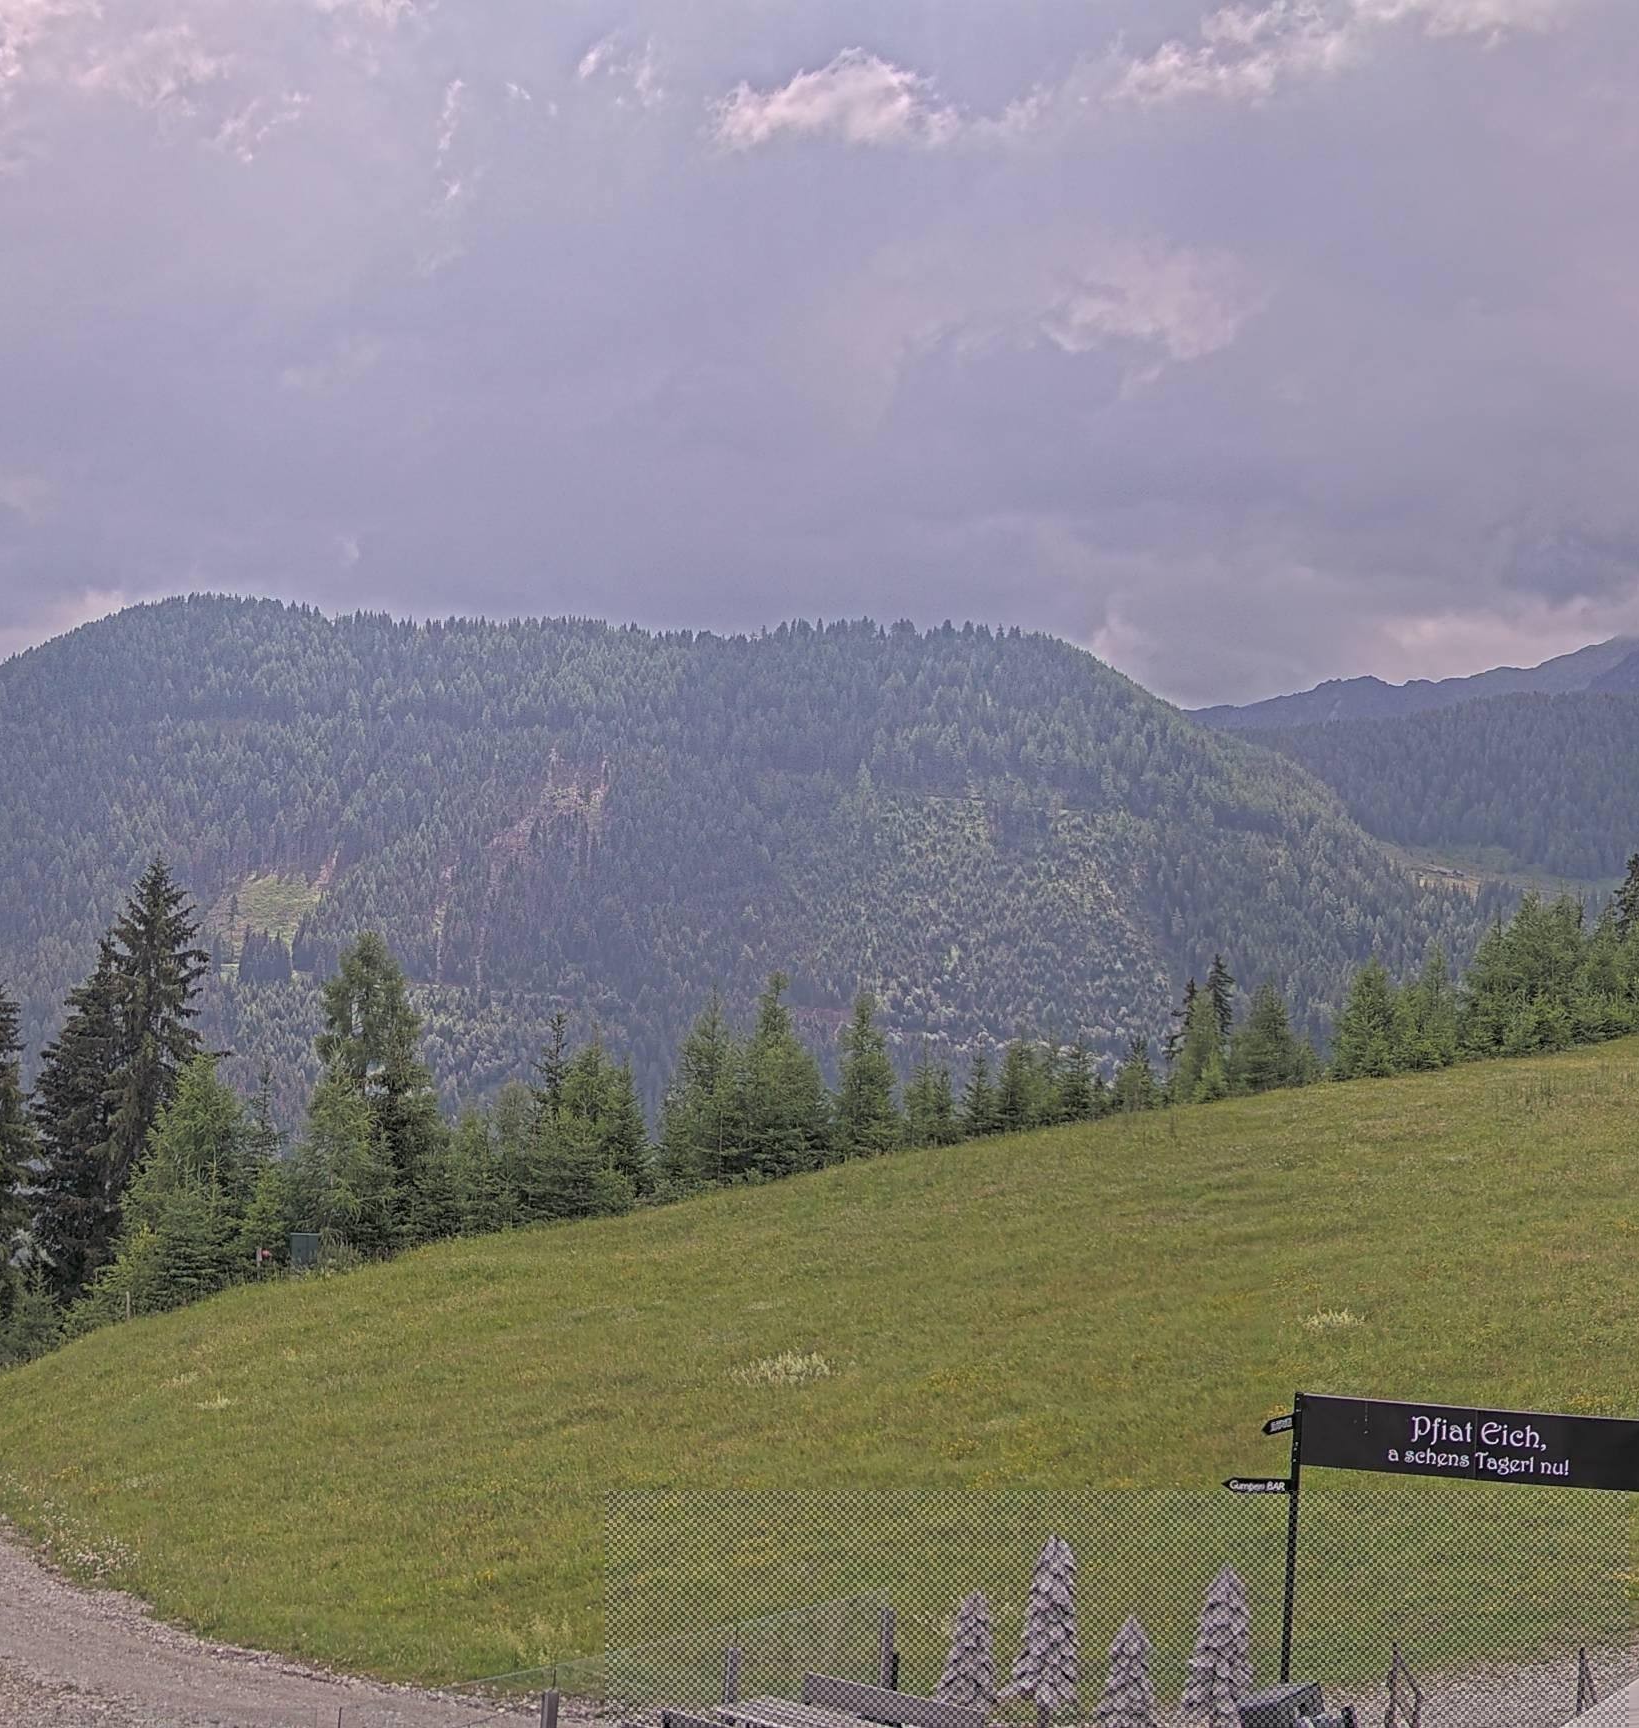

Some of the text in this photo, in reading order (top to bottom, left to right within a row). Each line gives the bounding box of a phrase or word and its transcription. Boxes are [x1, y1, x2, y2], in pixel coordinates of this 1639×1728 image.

[1410, 1415, 1547, 1450] Pfiat Eich,
[1388, 1448, 1570, 1476] a schens Tagerl nu!
[1265, 1481, 1285, 1491] BAR
